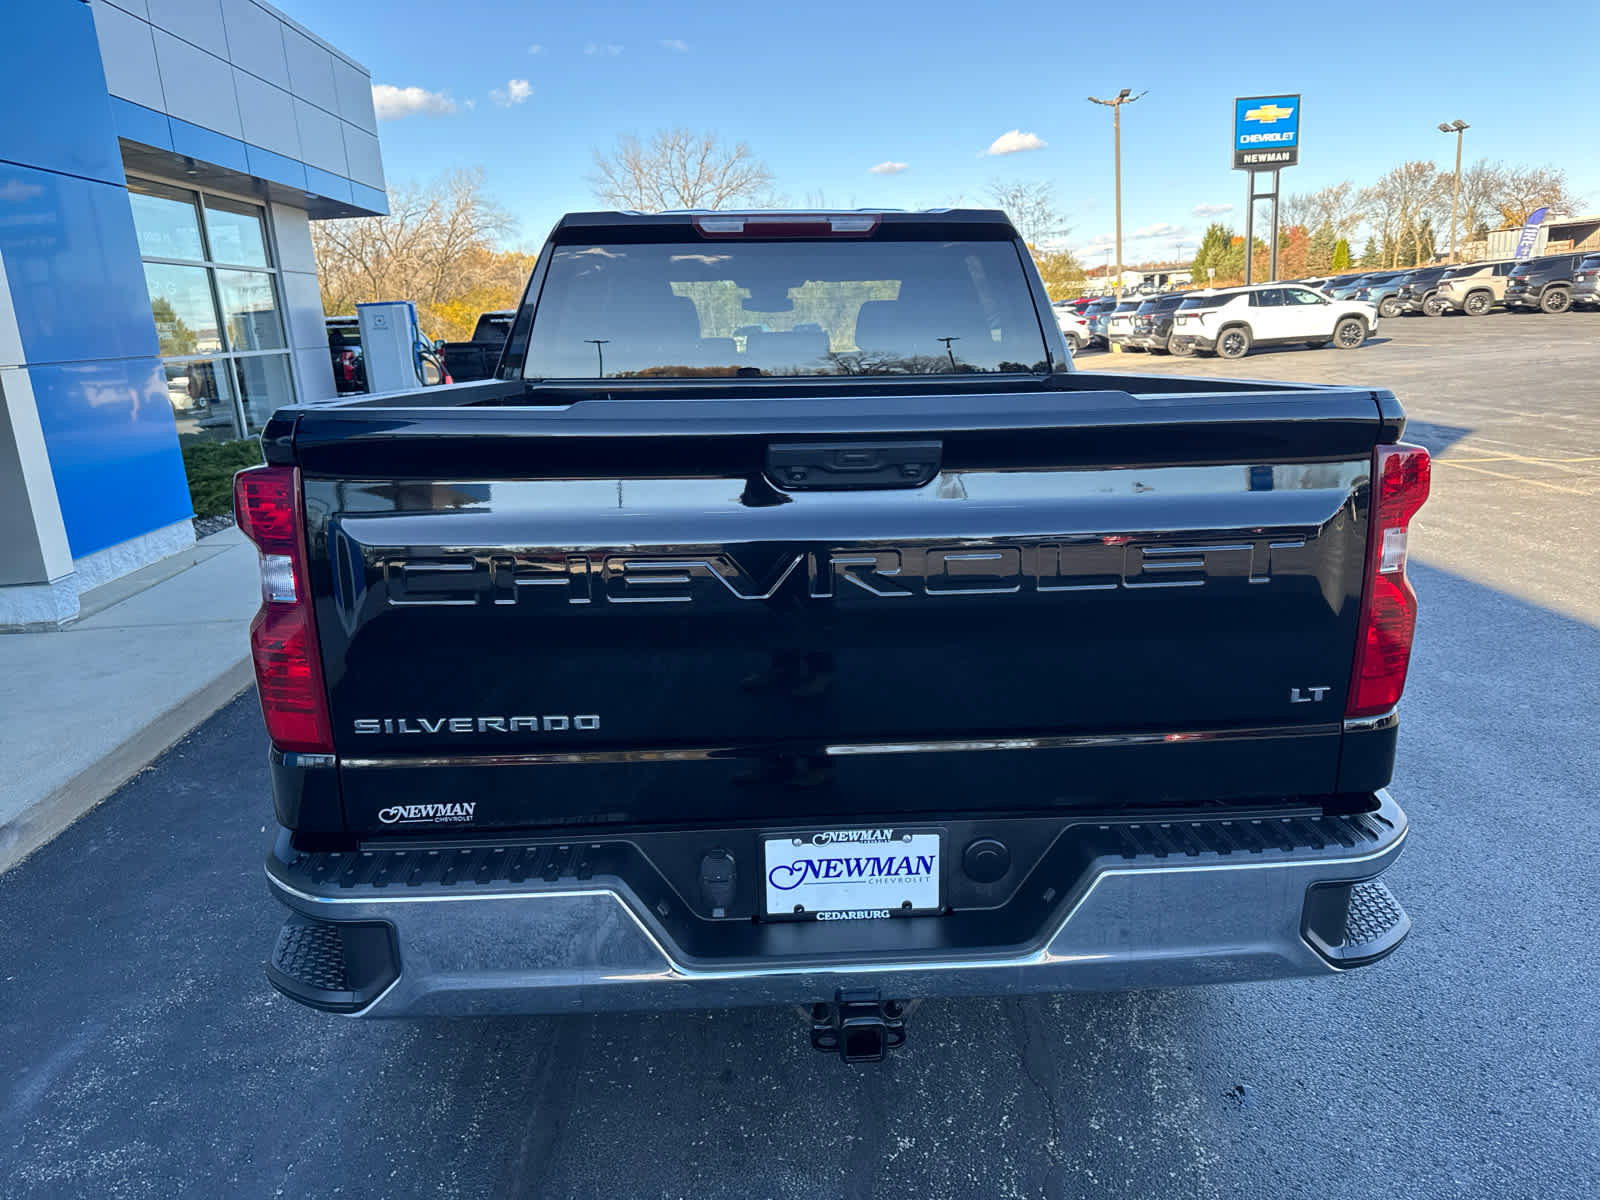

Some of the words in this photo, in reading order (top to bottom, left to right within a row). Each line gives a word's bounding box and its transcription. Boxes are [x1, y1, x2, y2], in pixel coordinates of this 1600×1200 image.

[1240, 132, 1295, 143] CHEVROLET
[1243, 152, 1290, 163] NEWMAN
[383, 537, 1306, 604] CHEVROLET
[1290, 686, 1331, 703] LT
[353, 714, 601, 735] SILVERADO
[378, 802, 476, 823] NEWMAN
[434, 815, 473, 823] CHEVROLET
[812, 829, 893, 847] NEWMAN
[768, 855, 936, 890] NEWMAN
[867, 876, 932, 885] CHEVROLET
[816, 910, 891, 921] CEDARBURG
